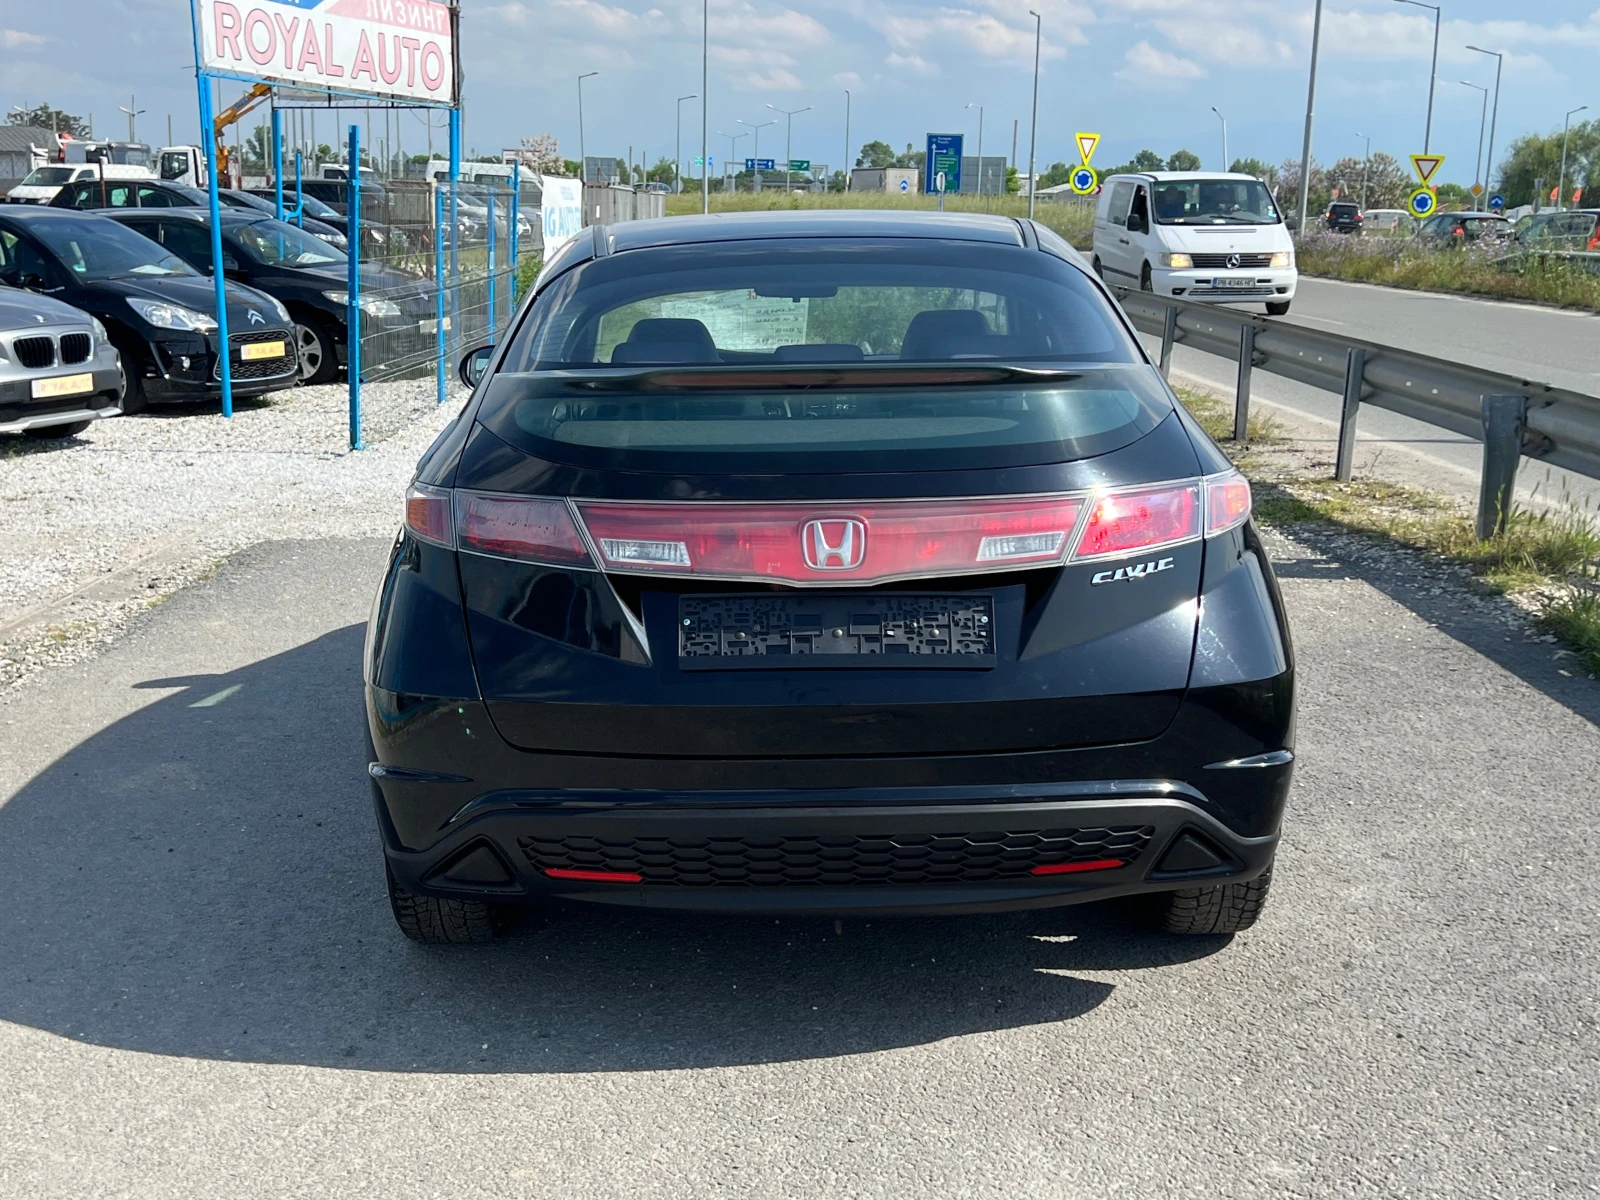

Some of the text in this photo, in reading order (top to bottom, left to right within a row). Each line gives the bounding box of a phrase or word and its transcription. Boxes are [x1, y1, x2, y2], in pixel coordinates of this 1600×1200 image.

[366, 0, 445, 32] ЛИЗИНГ
[213, 0, 446, 92] ROYAL AUTO
[1091, 557, 1174, 584] CIVIC
